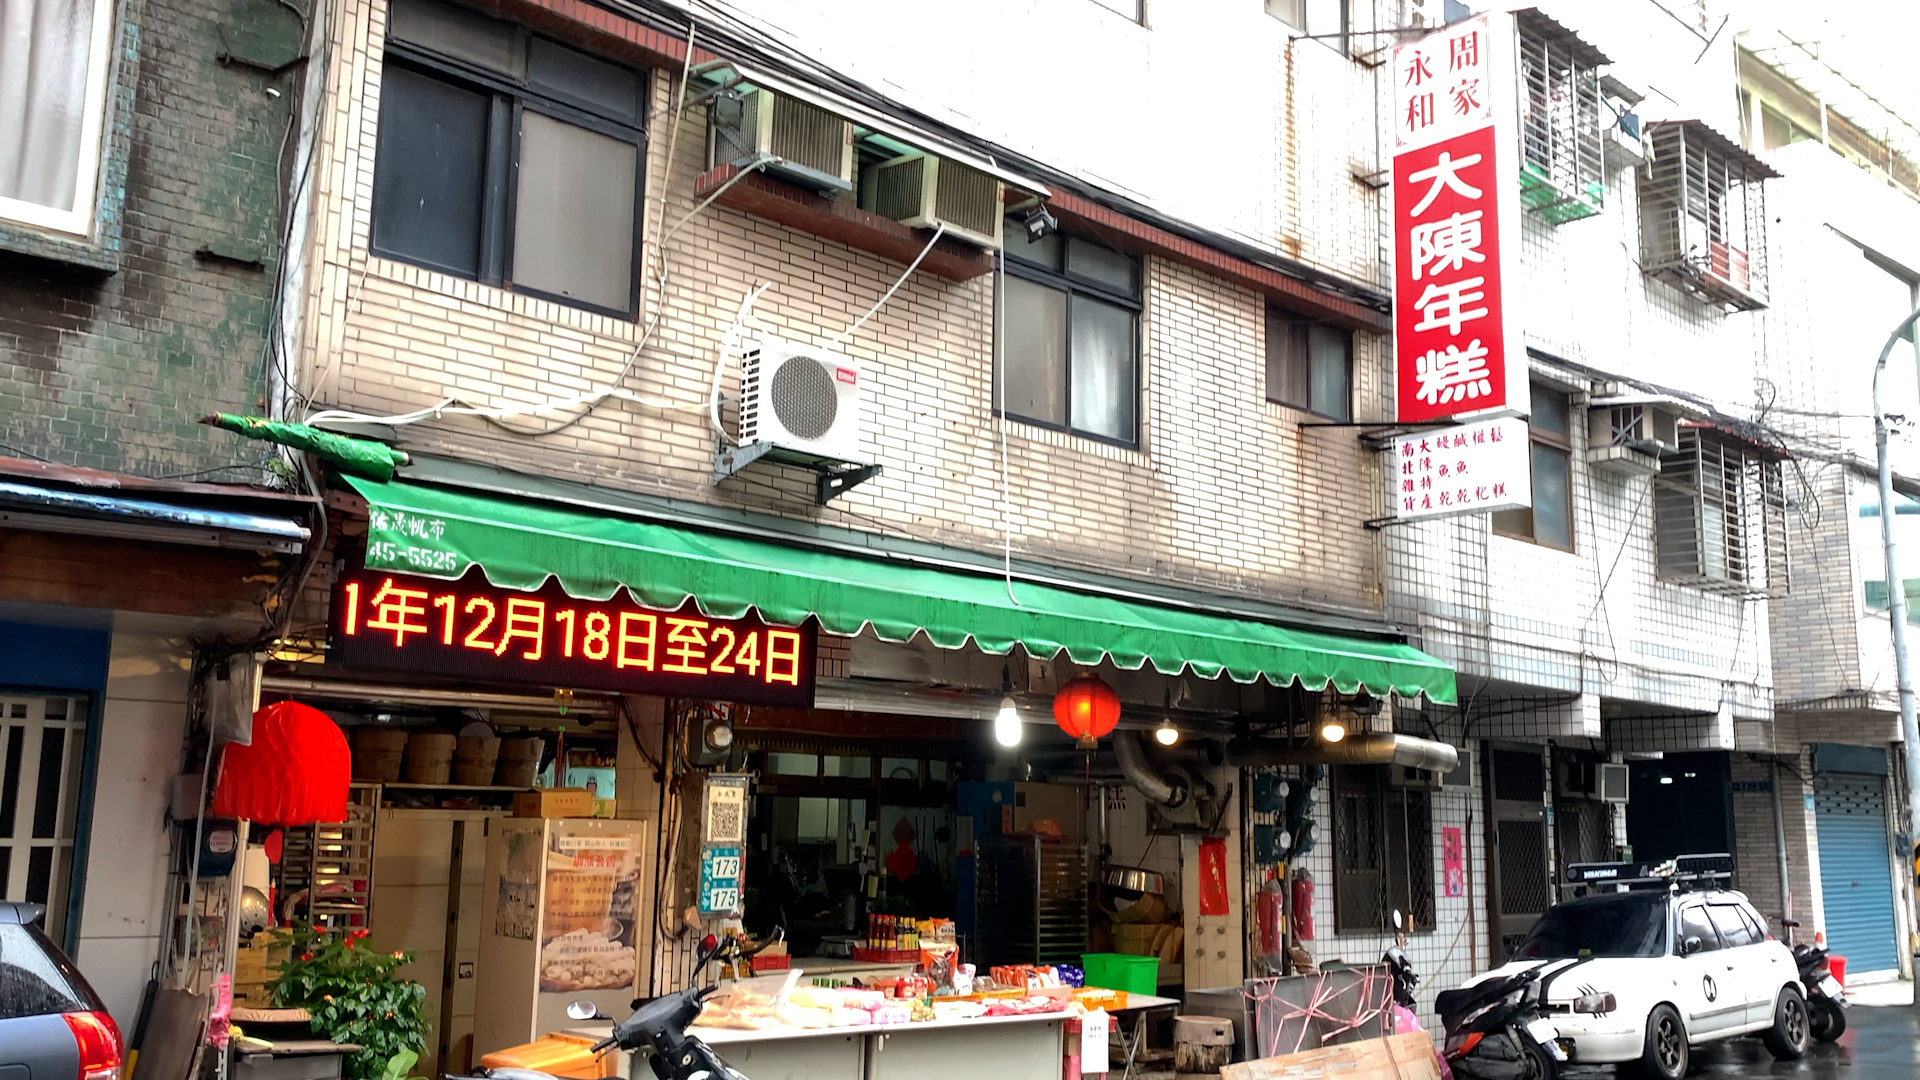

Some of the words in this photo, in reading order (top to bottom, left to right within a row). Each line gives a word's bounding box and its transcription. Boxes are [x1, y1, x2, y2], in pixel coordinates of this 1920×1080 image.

[1403, 49, 1435, 133] 永和
[1448, 30, 1482, 117] 周家
[1408, 151, 1493, 406] 大陳年糕
[1401, 441, 1416, 513] 南北雜貨
[1418, 438, 1433, 510] 大陳特產
[368, 541, 458, 572] 45-5525
[342, 577, 802, 688] 1年12月18日至24日
[713, 890, 737, 908] 175
[715, 859, 738, 876] 173
[1583, 868, 1618, 880] YAKIMA
